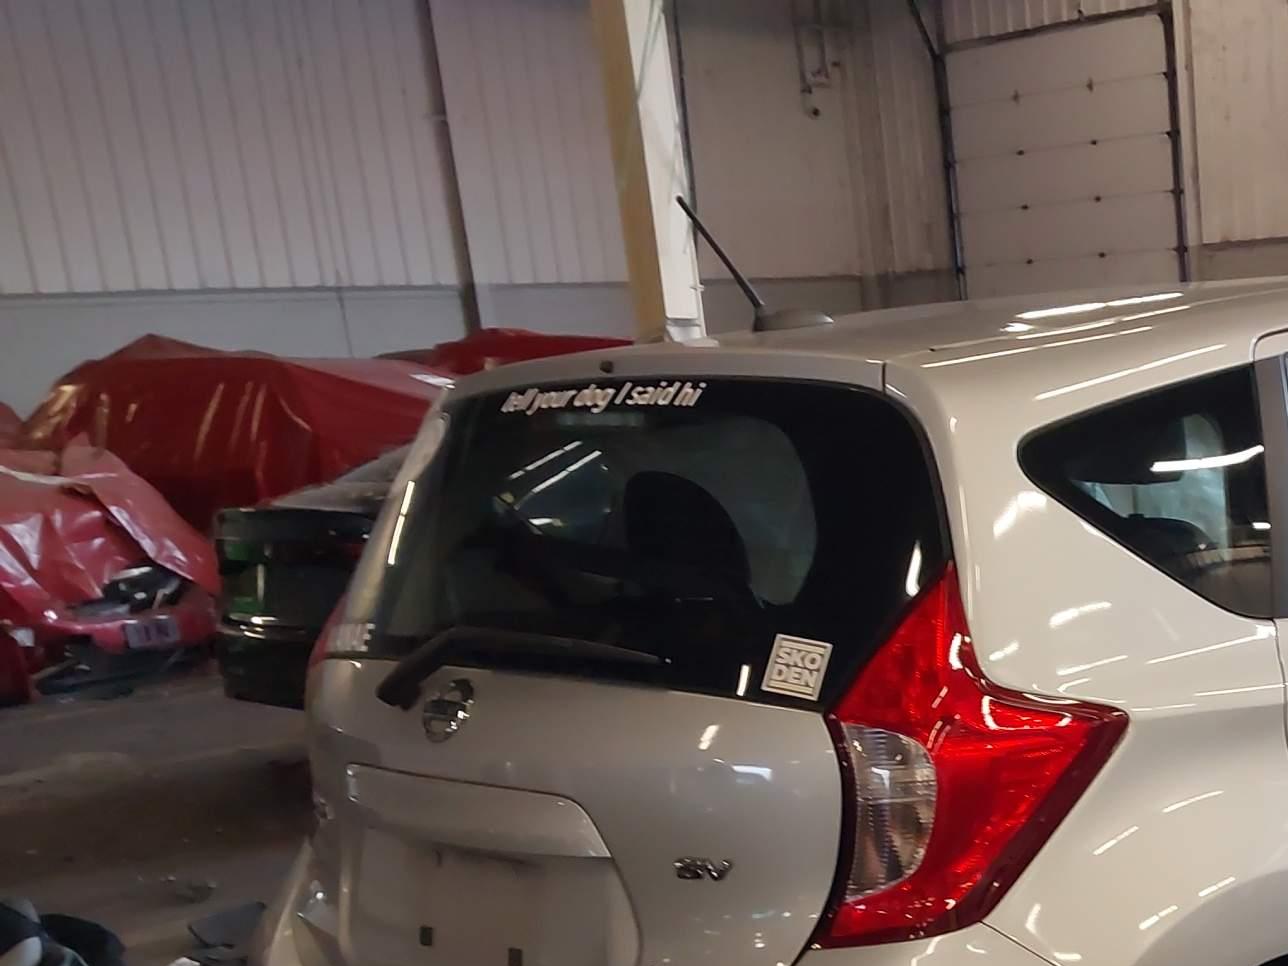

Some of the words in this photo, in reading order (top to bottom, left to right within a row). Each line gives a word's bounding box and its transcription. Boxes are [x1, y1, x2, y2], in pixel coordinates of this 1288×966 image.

[501, 388, 539, 413] tell
[526, 389, 577, 416] your
[573, 384, 616, 414] dog
[625, 381, 682, 406] said
[673, 381, 707, 407] hi
[775, 647, 822, 671] SKO
[771, 664, 819, 688] DEN
